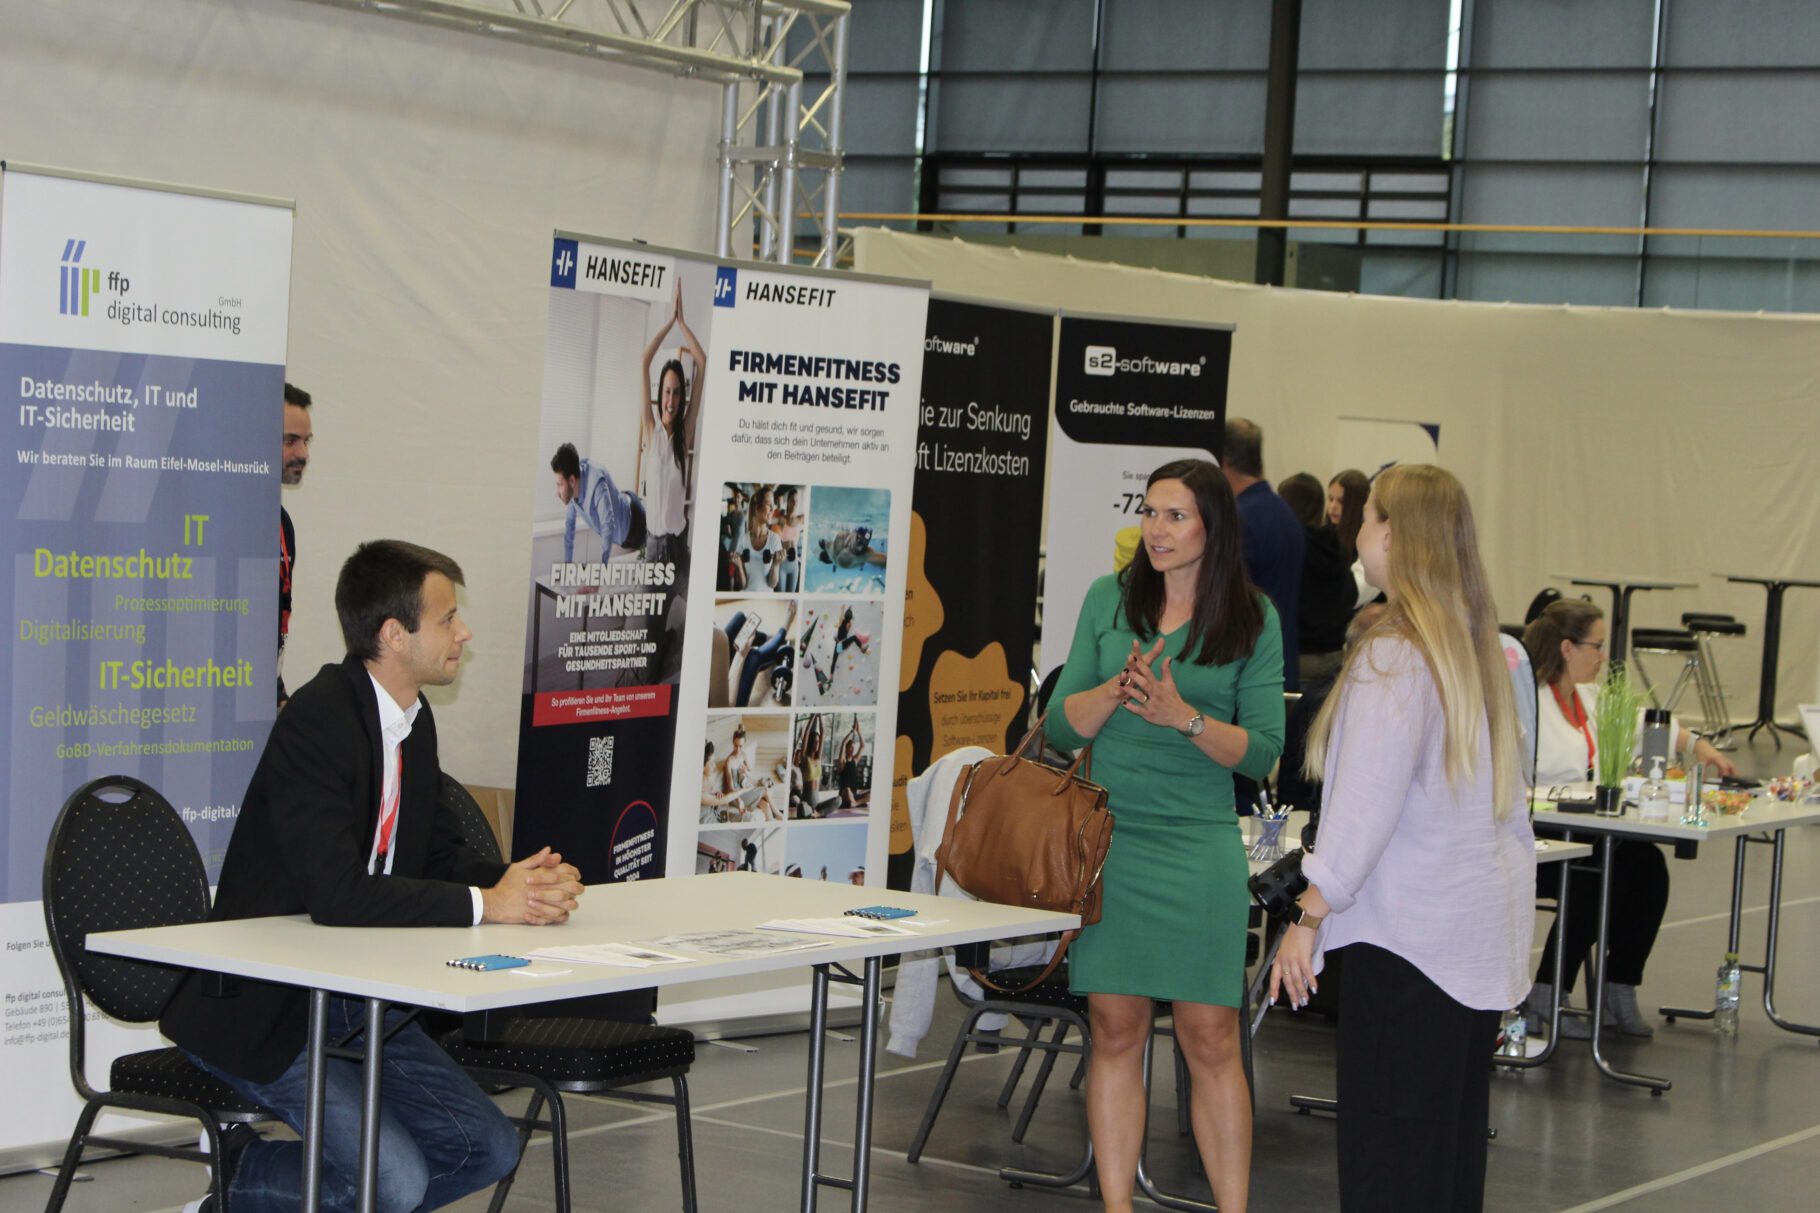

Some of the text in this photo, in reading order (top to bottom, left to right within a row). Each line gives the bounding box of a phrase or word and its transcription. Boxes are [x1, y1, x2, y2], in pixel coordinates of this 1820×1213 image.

[107, 271, 130, 296] ffp
[586, 255, 666, 288] HANSEFIT
[218, 296, 242, 308] GmbH
[746, 281, 836, 307] HANSEFIT
[107, 301, 241, 335] digital consulting
[729, 349, 901, 384] FIRMENFITNESS
[21, 377, 198, 409] Datenschutz, IT und
[739, 380, 889, 411] MIT HANSEFIT
[20, 405, 135, 432] IT-Sicherheit
[939, 407, 964, 429] zur
[967, 402, 1032, 441] Senkung
[1070, 399, 1215, 420] Gebrauchte Software-Lizenzen
[739, 418, 750, 429] Du
[771, 421, 787, 431] dich
[800, 422, 813, 433] und
[816, 424, 844, 435] gesund,
[847, 426, 858, 435] wir
[860, 428, 885, 439] sorgen
[755, 435, 772, 445] dass
[774, 436, 789, 446] sich
[792, 436, 808, 447] dein
[810, 438, 860, 450] Unternehmen
[861, 441, 879, 451] aktiv
[880, 443, 890, 452] an
[17, 450, 269, 475] Wir beraten Sie im Raum Eifel-Mosel-Hunsrück
[767, 450, 782, 460] den
[784, 450, 820, 464] Beiträgen
[914, 442, 1029, 476] ft Lizenzkosten
[184, 514, 209, 546] IT
[34, 548, 193, 579] Datenschutz
[550, 562, 675, 586] FIRMENFITNESS
[115, 594, 249, 615] Prozessoptimierung
[556, 593, 666, 618] MIT HANSEFIT
[20, 619, 147, 646] Digitalisierung
[570, 629, 648, 643] EINE MITGLIEDSCHAFT
[558, 643, 656, 658] FÜR TAUSENDE SPORT- UND
[100, 659, 253, 690] IT-Sicherheit
[566, 657, 647, 672] GESUNDHEITSPARTNER
[30, 703, 197, 729] Geldwäschegesetz
[56, 738, 254, 759] GoBD-Verfahrensdokumentation
[613, 829, 655, 855] FIRMENFITNESS
[615, 842, 652, 866] IN HÖCHSTER
[613, 853, 653, 879] QUALITÄT SEIT
[6, 941, 31, 952] Folgen
[33, 940, 44, 948] Sie
[18, 990, 40, 1002] digital
[42, 988, 66, 999] consul
